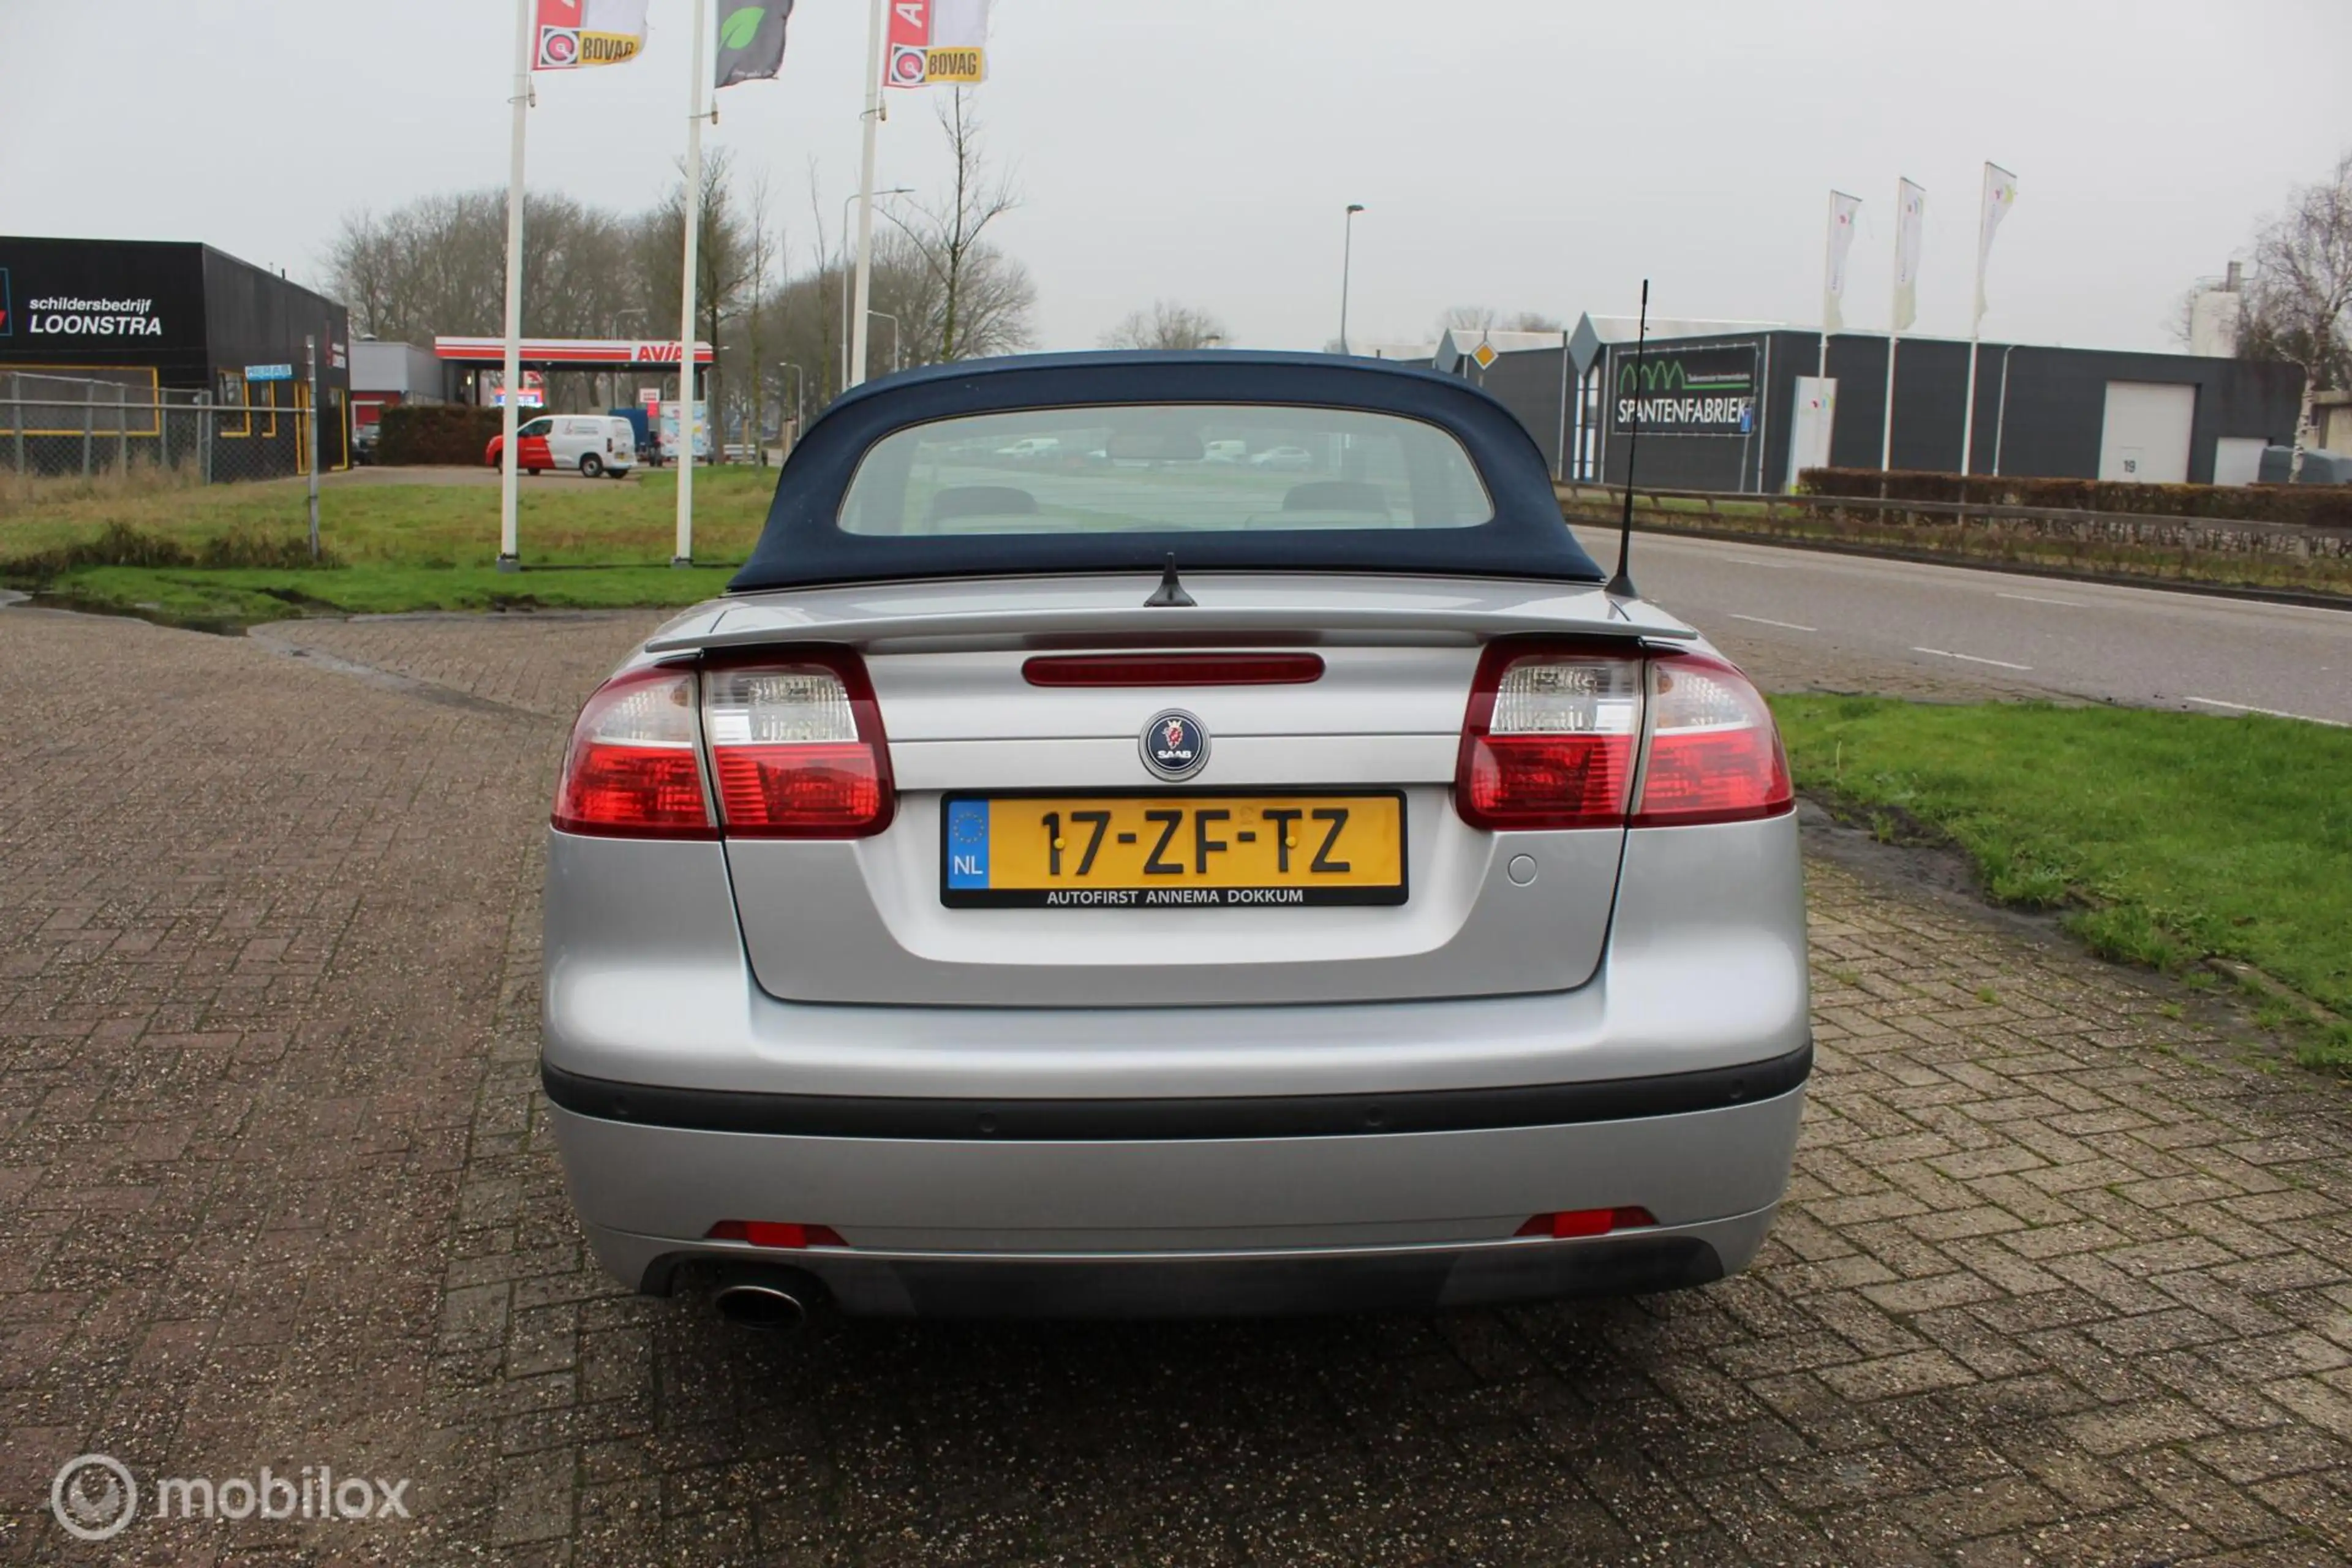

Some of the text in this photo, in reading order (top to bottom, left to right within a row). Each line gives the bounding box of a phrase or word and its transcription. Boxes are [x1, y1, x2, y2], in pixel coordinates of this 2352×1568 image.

[929, 53, 977, 75] BOVAG
[29, 296, 151, 314] schildersbedrijf
[30, 315, 162, 335] LOONSTRA
[1618, 398, 1745, 423] SPANTENFABRIEK
[2124, 460, 2136, 473] 19
[1158, 750, 1191, 759] SAAB
[1042, 809, 1351, 876] 17-ZF-TZ
[954, 855, 982, 875] NL
[1046, 889, 1304, 905] AUTOFIRST ANNEMA DOKKUM
